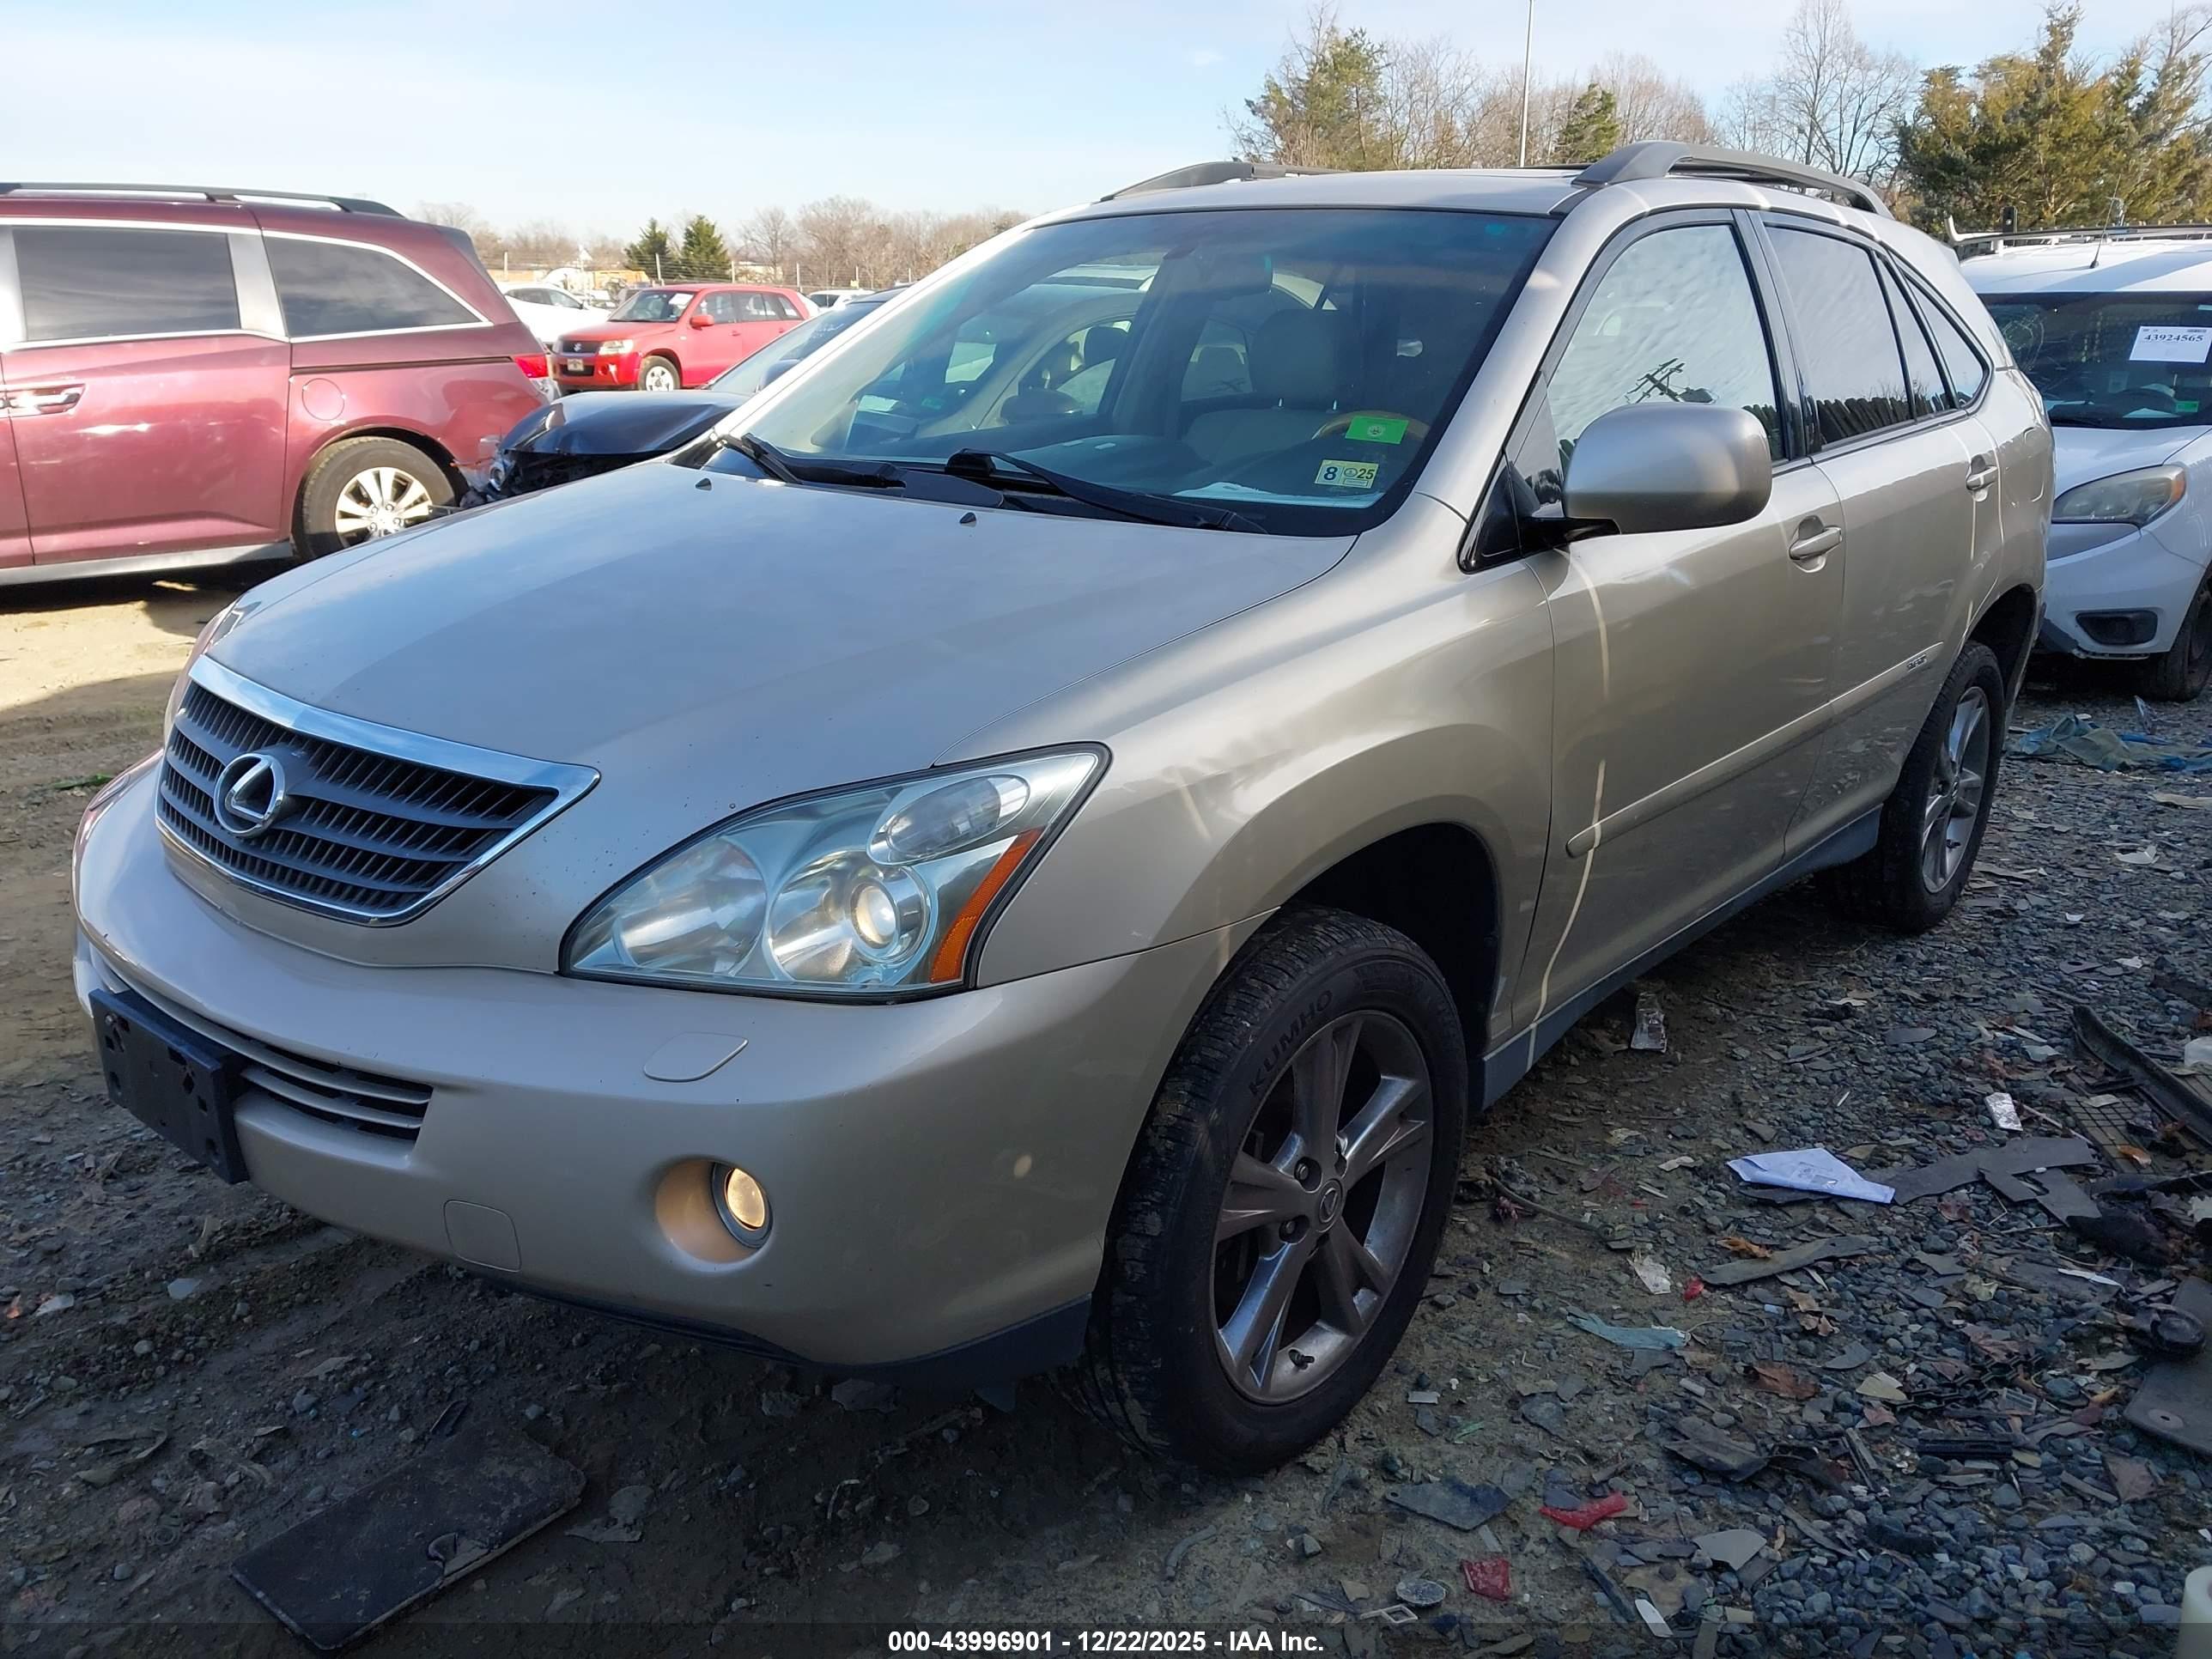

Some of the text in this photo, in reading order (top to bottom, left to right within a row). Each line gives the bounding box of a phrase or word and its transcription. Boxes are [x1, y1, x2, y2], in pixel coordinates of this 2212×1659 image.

[2143, 334, 2204, 343] 43924565
[1323, 466, 1375, 481] 8 25
[1249, 989, 1333, 1097] KUMHO
